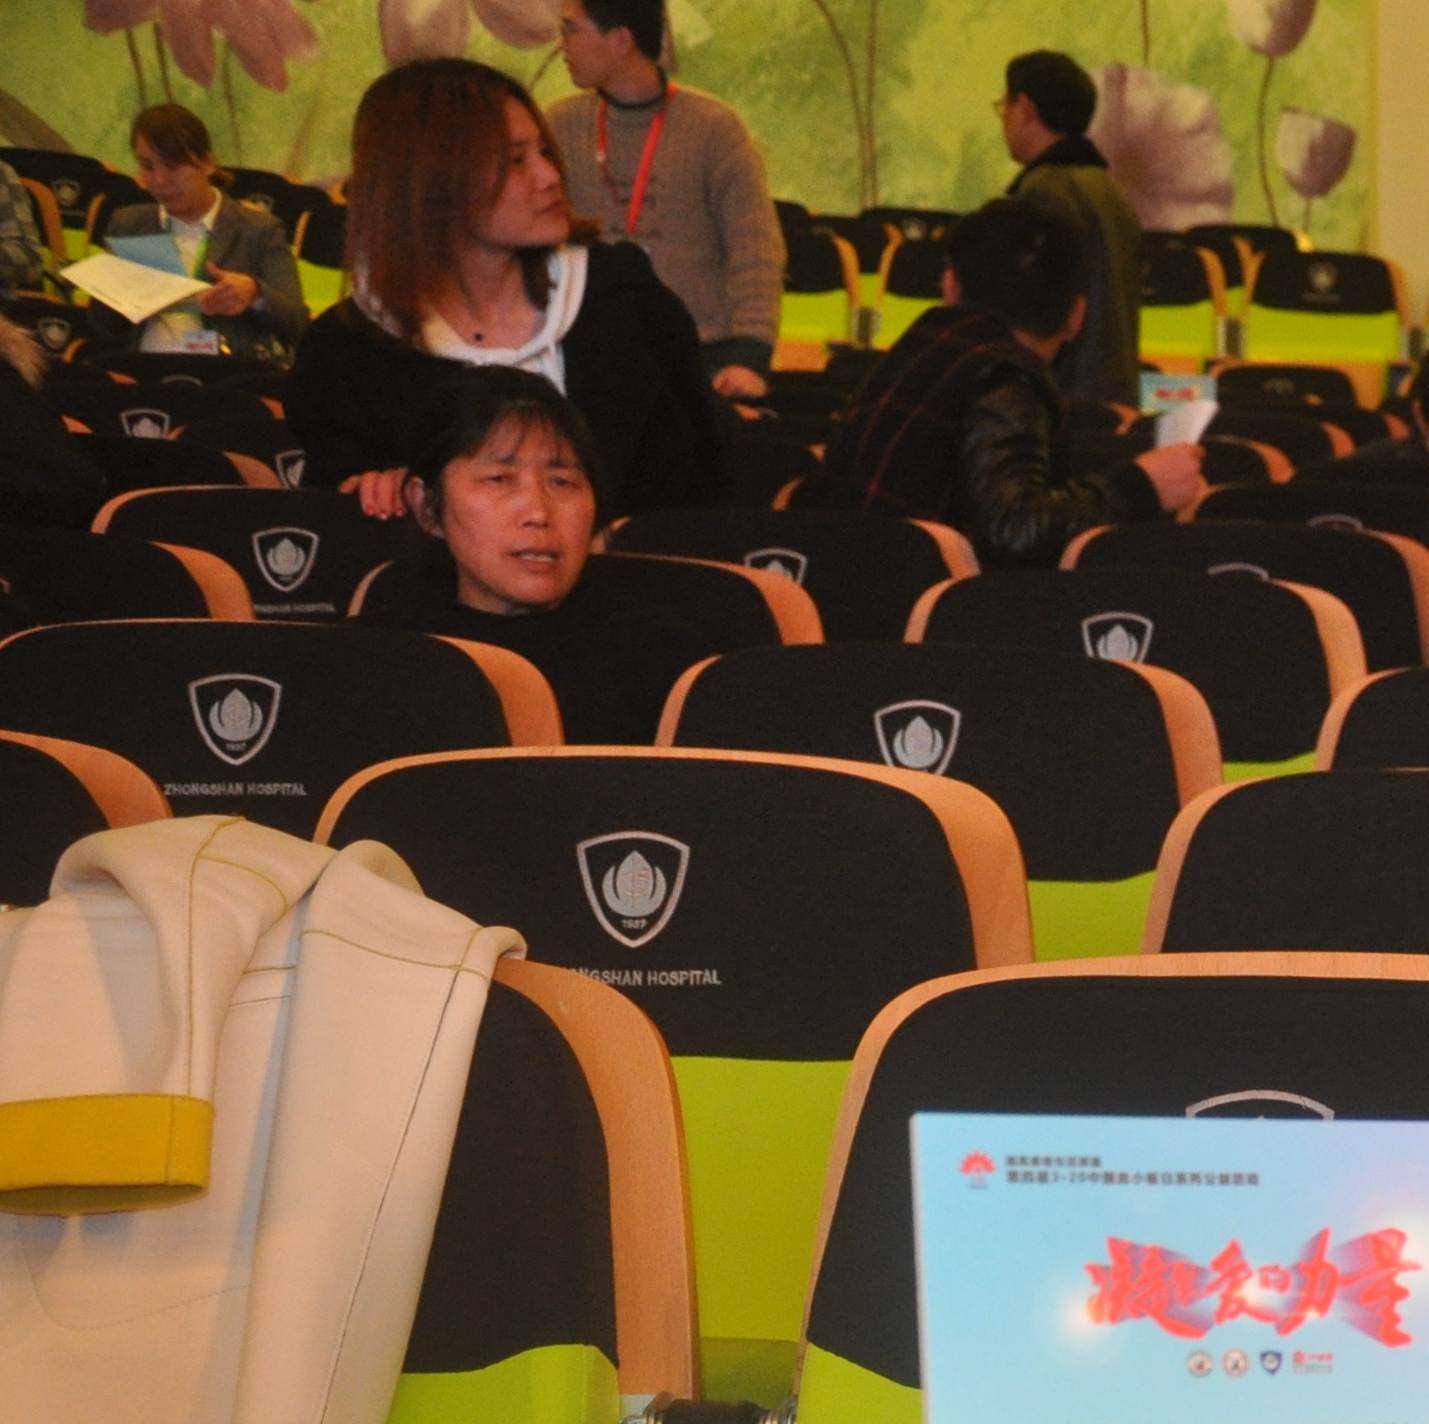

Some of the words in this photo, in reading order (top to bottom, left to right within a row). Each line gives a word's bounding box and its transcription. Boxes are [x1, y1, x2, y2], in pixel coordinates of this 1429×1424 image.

[163, 782, 245, 797] ZHONGSHAN
[248, 782, 308, 797] HOSPITAL
[648, 968, 723, 986] HOSPITAL
